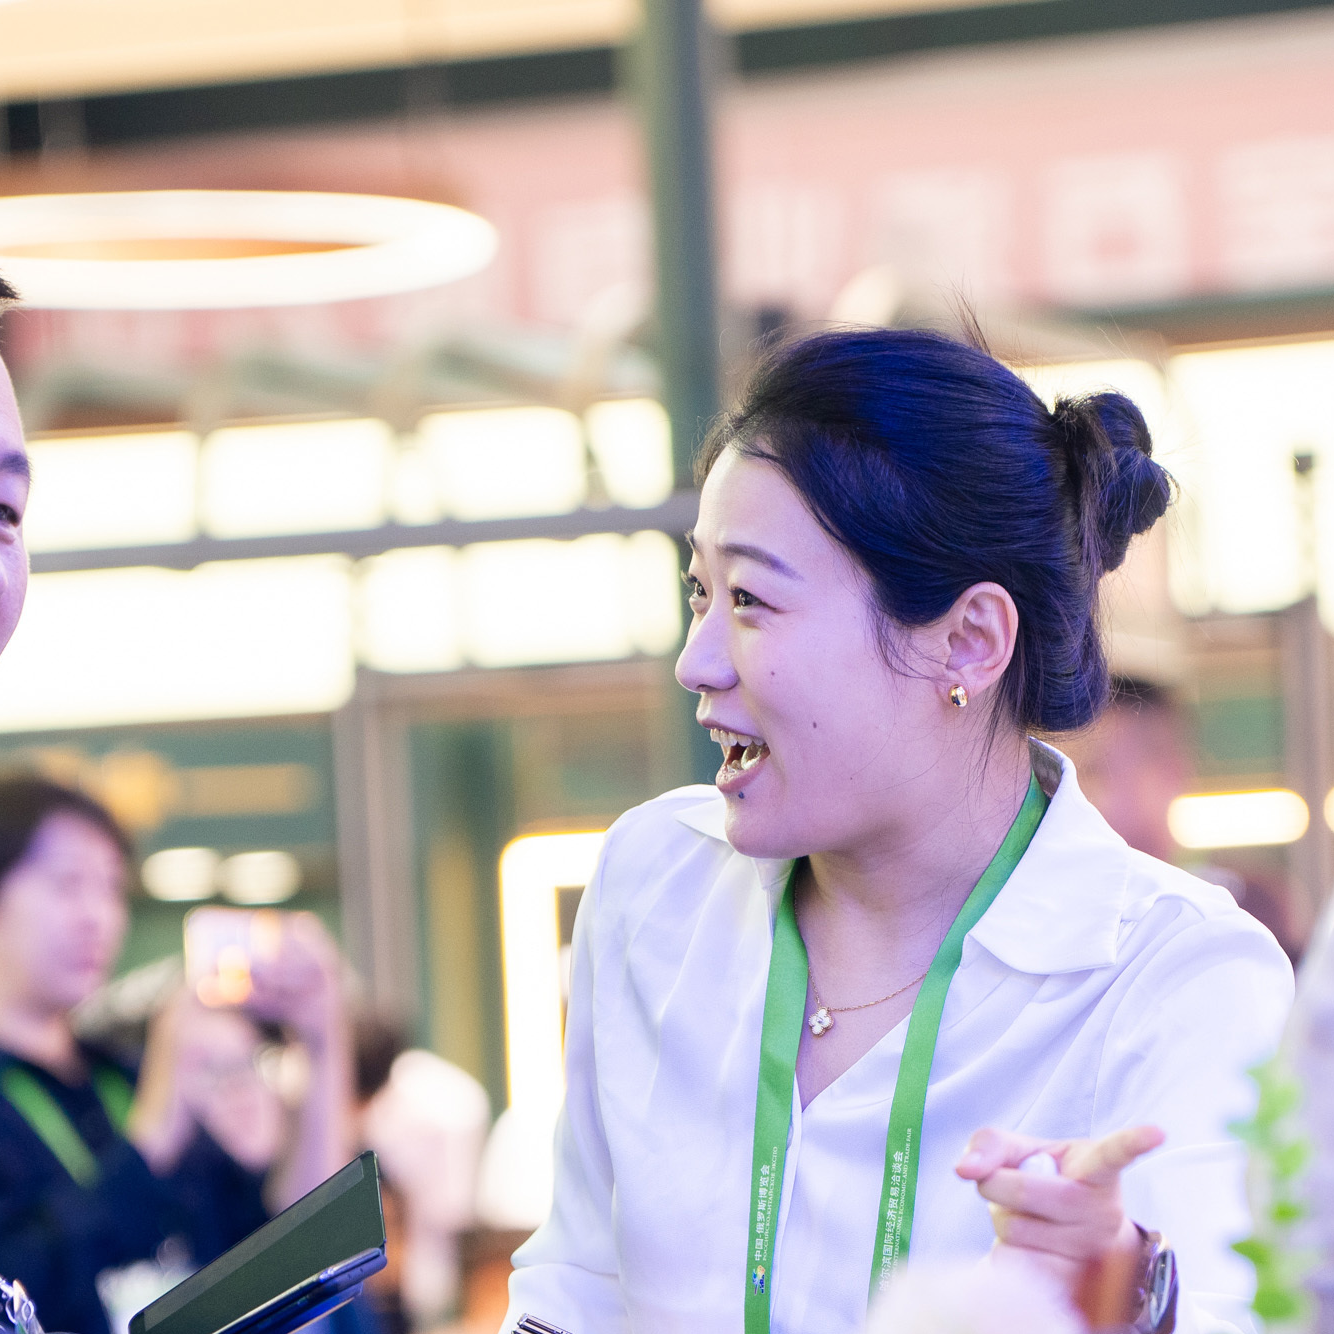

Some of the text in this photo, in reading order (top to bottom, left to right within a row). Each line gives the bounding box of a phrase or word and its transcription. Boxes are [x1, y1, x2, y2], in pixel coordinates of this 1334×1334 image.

[754, 1164, 770, 1261] 中国-俄罗斯博览会
[893, 1216, 903, 1266] INTERNATIONAL
[899, 1181, 907, 1215] ECONOMIC
